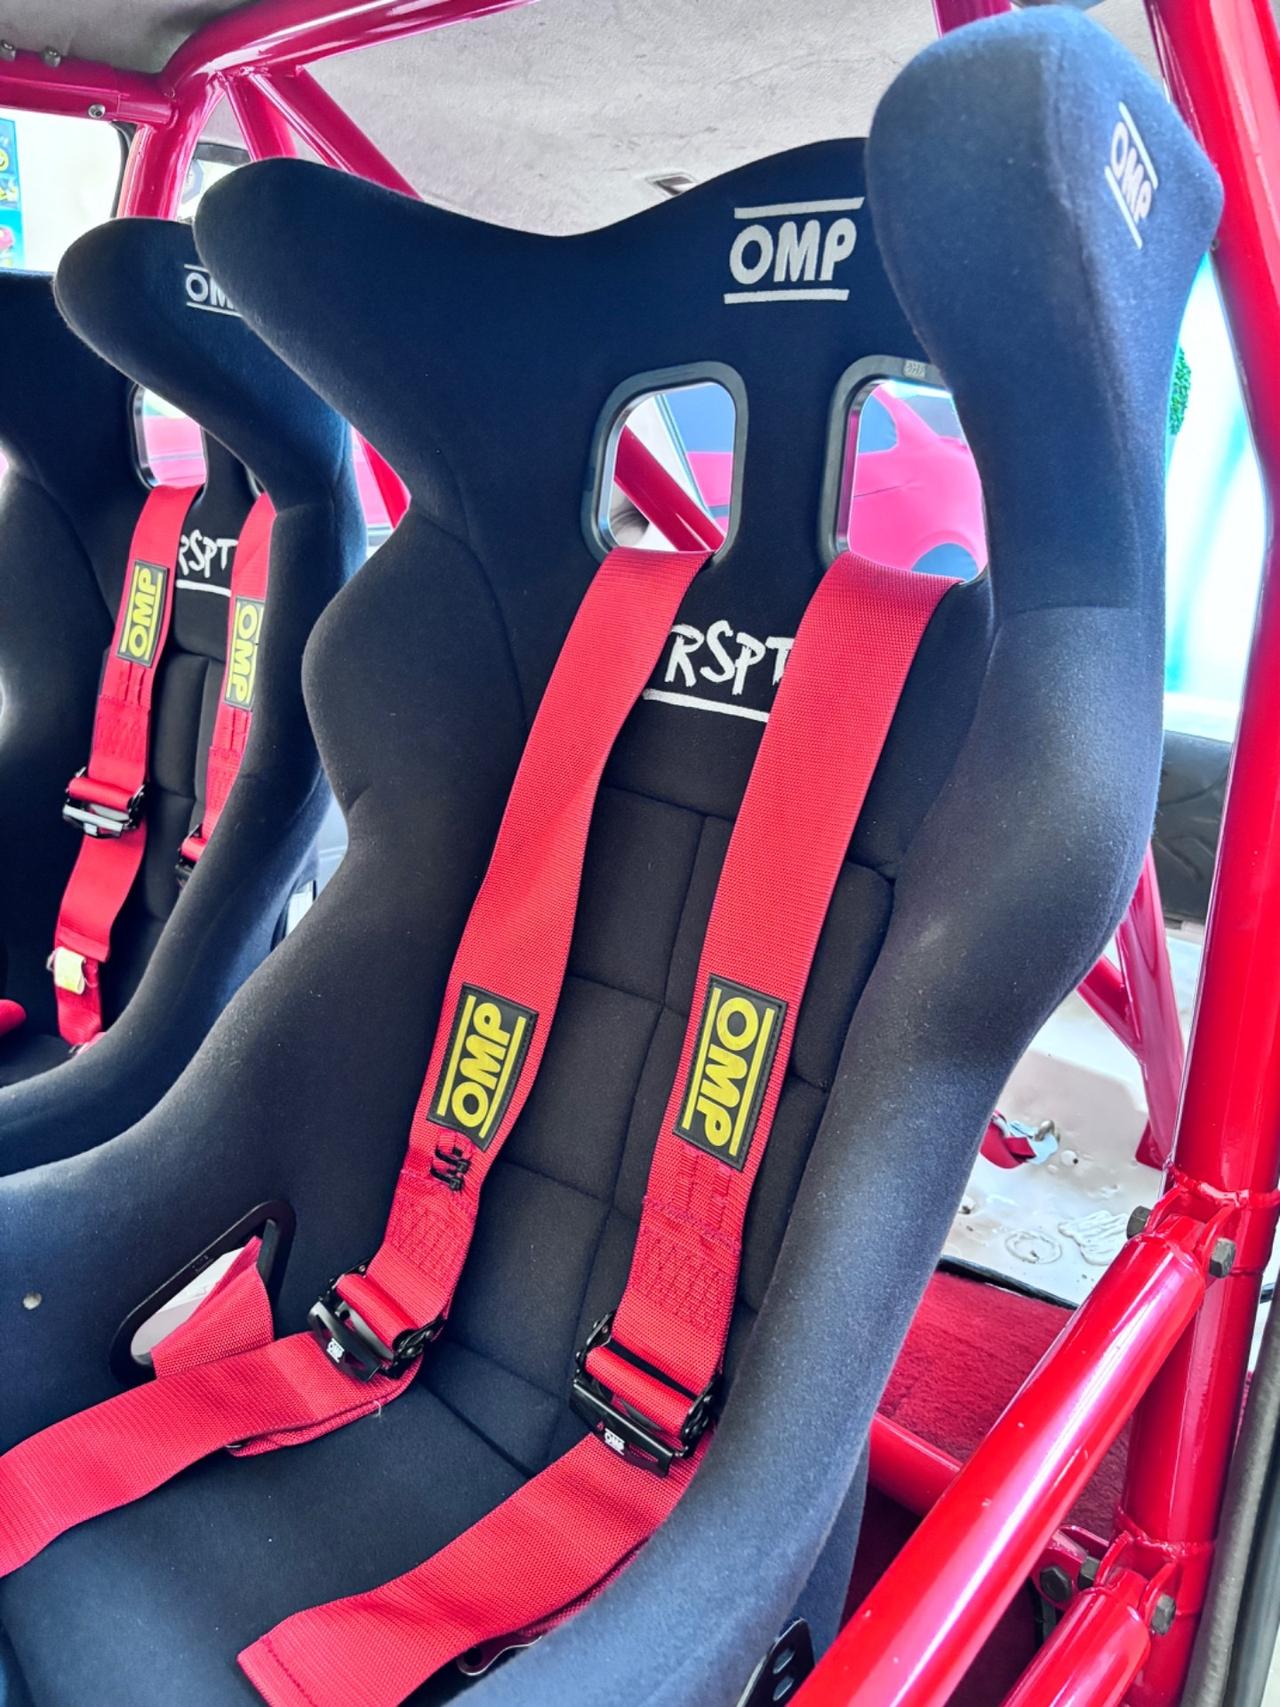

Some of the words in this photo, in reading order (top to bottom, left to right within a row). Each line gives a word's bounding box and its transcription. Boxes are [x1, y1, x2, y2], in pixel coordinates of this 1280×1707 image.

[1110, 121, 1152, 224] OMP
[185, 271, 235, 310] OM
[729, 217, 857, 285] OMP
[128, 567, 157, 657] OMP
[231, 603, 258, 701] OMP
[664, 619, 796, 696] RSPT
[451, 1002, 511, 1128] OMP
[696, 996, 760, 1147] OMP
